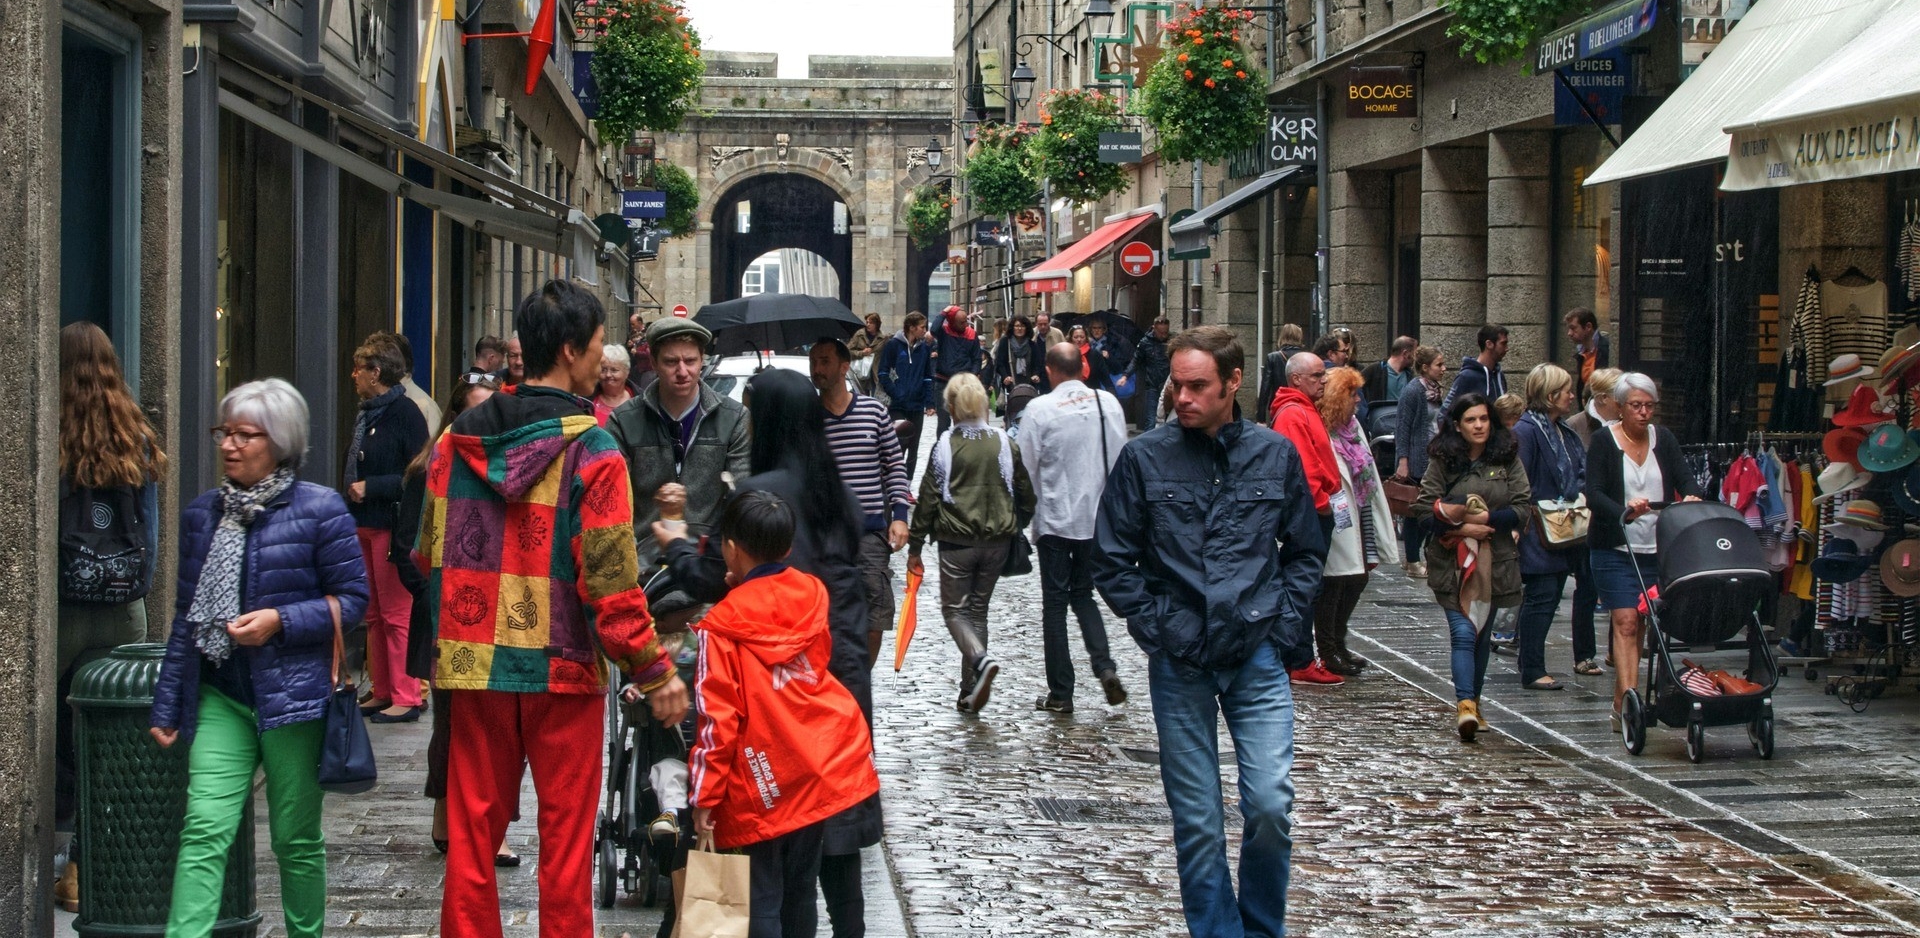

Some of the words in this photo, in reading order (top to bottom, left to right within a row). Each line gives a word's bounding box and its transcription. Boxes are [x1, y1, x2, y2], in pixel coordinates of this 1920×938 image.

[1539, 33, 1576, 70] EPICES
[1574, 60, 1613, 71] EPICES
[1349, 85, 1413, 99] BOCAGE
[1365, 104, 1398, 112] HOMME
[1270, 145, 1317, 161] OLAM
[1794, 130, 1830, 168] AUX
[1833, 118, 1901, 164] DELICES
[757, 752, 774, 781] SPORTS
[748, 758, 774, 809] PERFORMANCE
